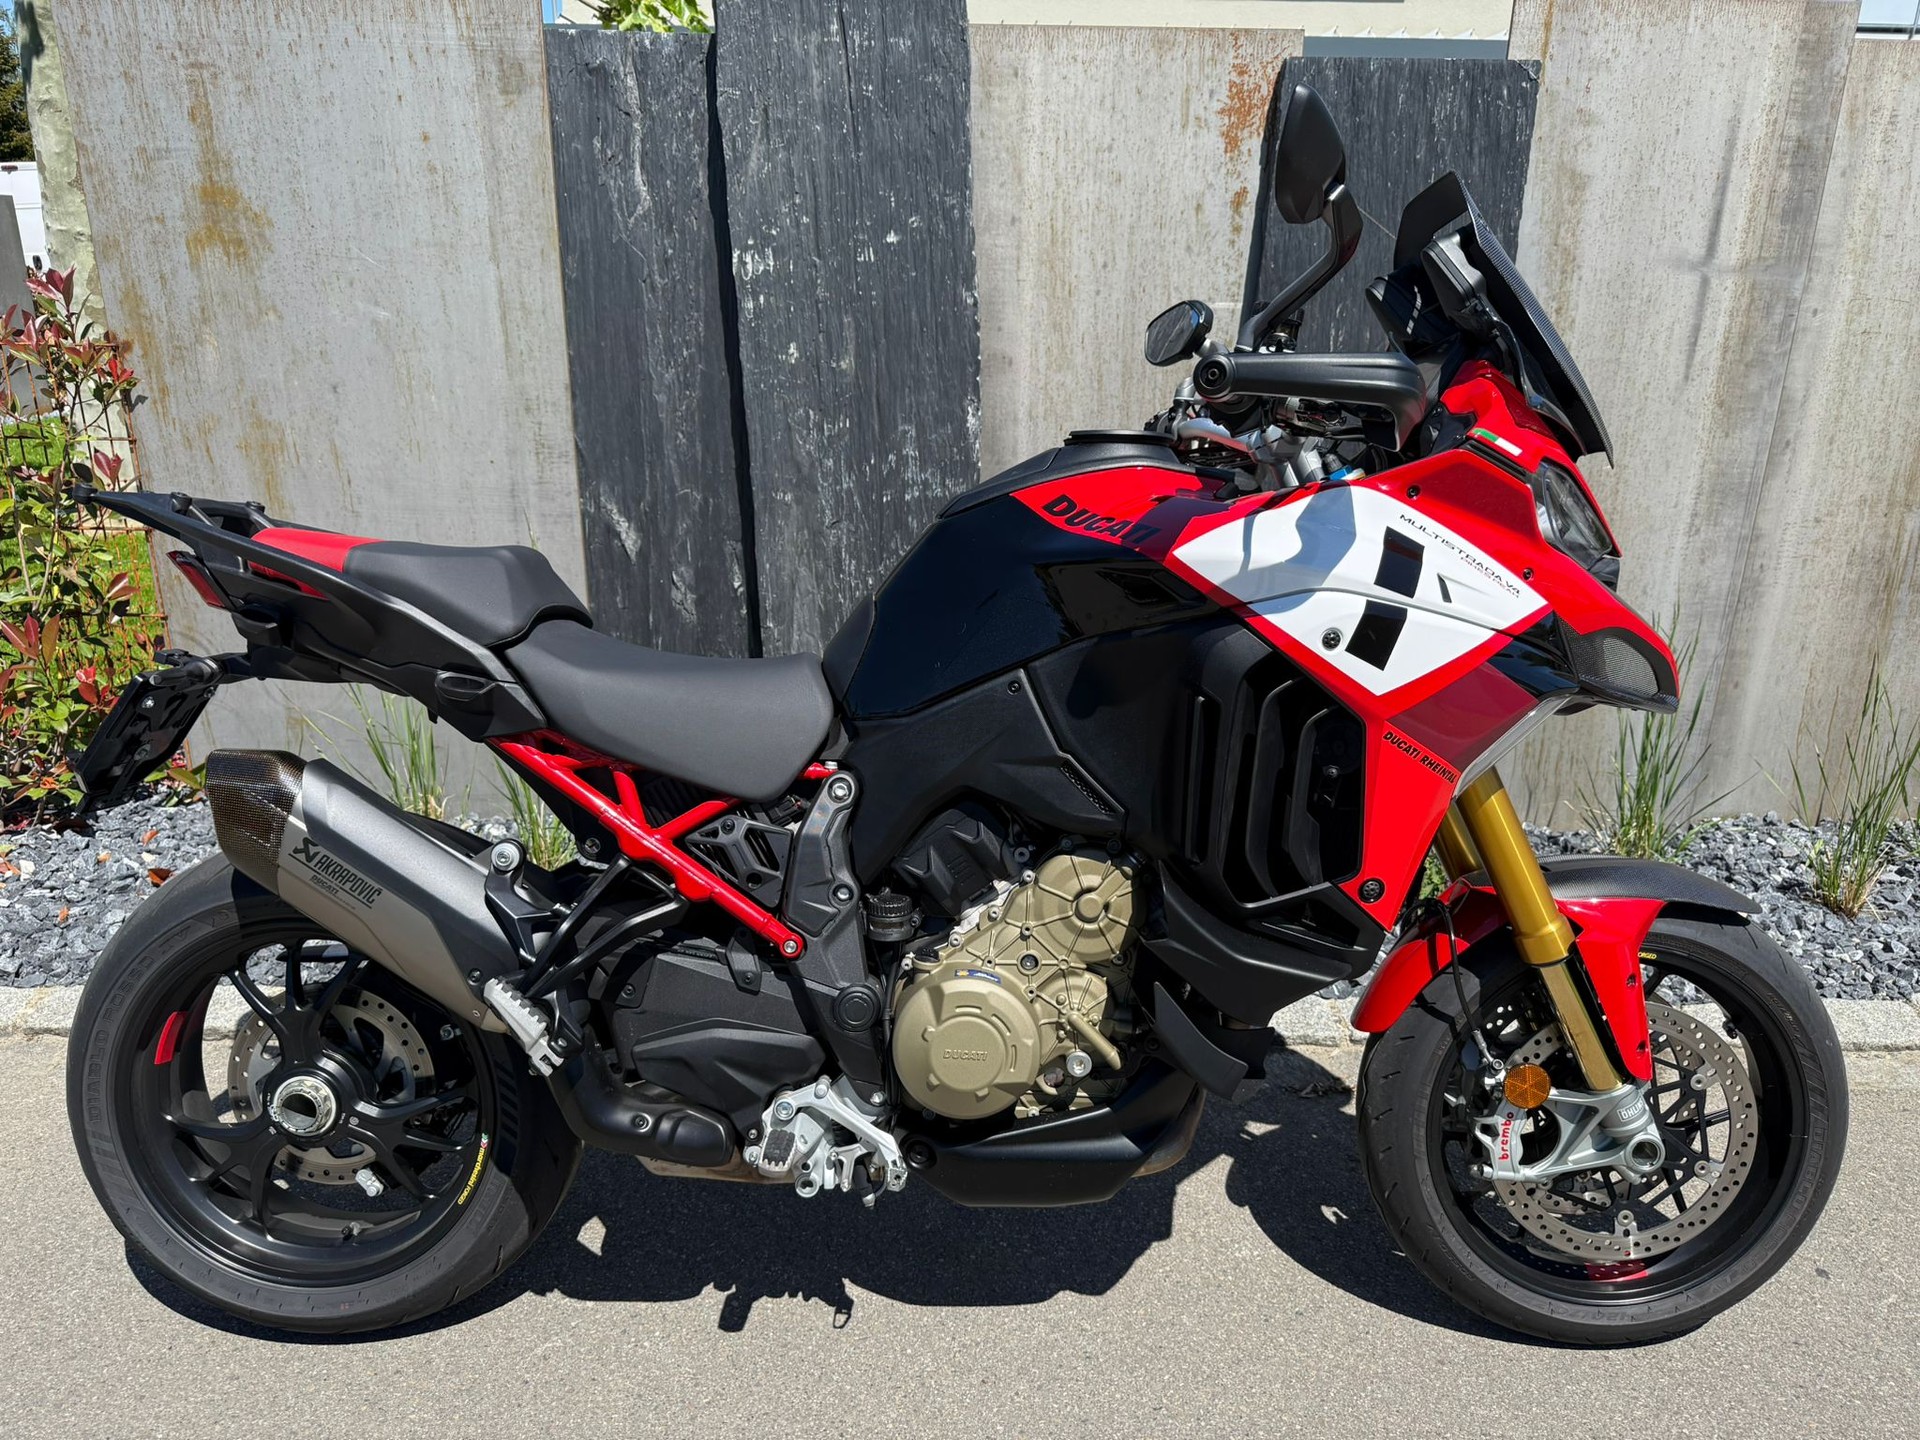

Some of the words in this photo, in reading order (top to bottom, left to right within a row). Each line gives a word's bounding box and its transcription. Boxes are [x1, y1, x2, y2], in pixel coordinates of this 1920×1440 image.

[1042, 493, 1161, 545] DUCATI
[1399, 513, 1504, 582] MULTISTRADA
[1505, 580, 1520, 596] V4
[1382, 730, 1421, 760] DUCATI
[1419, 754, 1457, 784] RHEINTAL
[310, 874, 340, 895] DUCATI
[1637, 951, 1658, 960] ORGED
[88, 1028, 108, 1124] DIABLO
[103, 954, 155, 1024] ROSSO
[943, 1048, 988, 1062] DUCATI
[1498, 1111, 1514, 1163] brembo
[466, 1147, 486, 1188] marchesini
